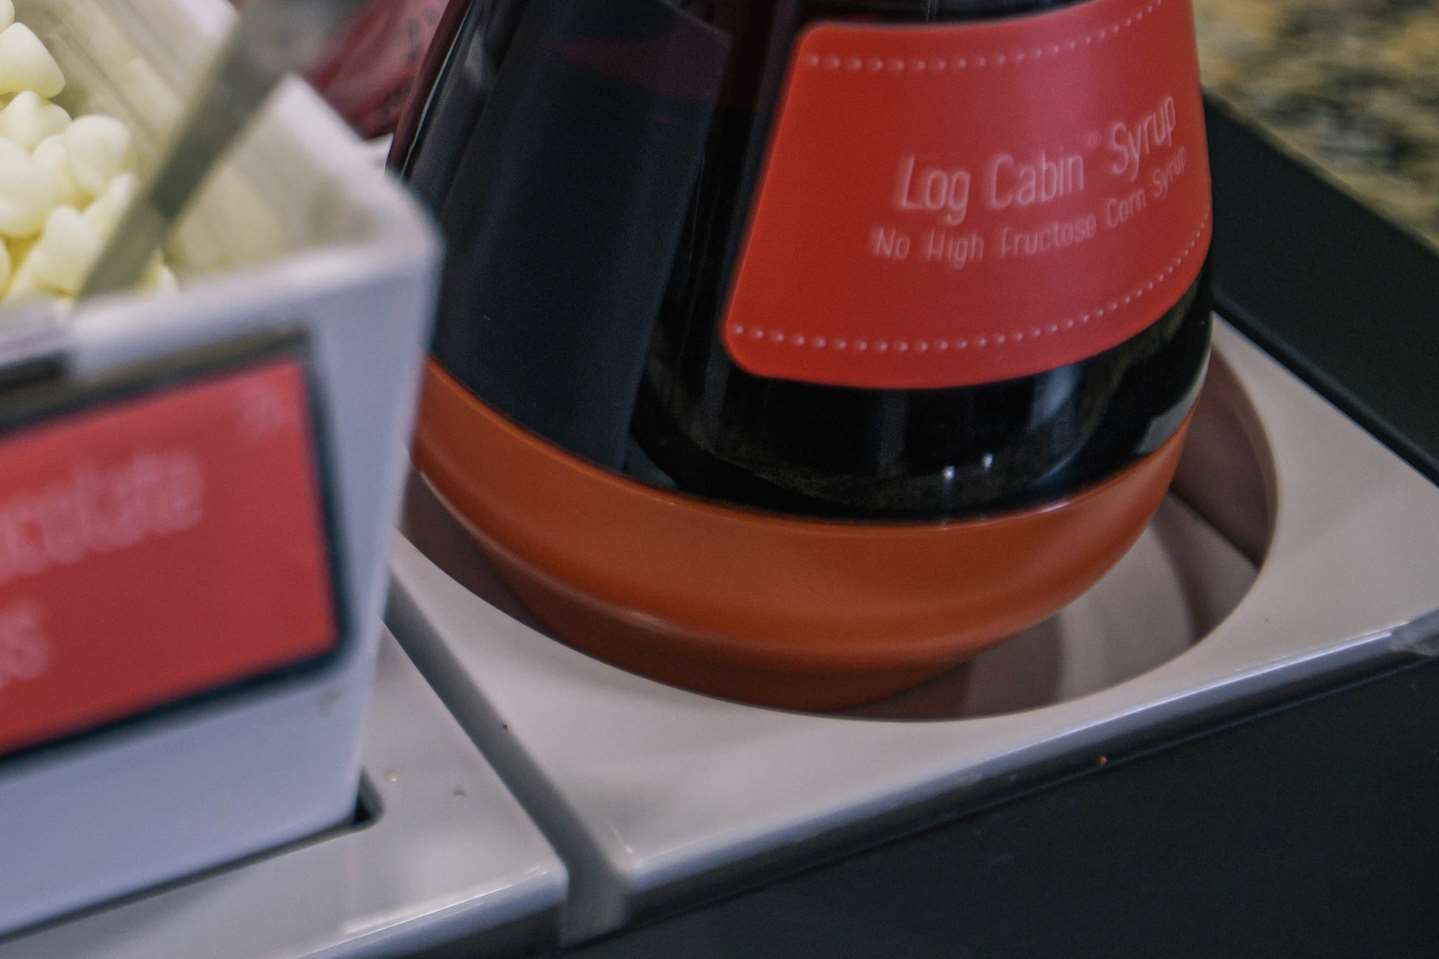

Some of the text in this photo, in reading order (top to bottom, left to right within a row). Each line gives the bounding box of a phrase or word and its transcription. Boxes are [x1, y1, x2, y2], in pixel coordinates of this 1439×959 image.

[896, 154, 971, 225] Log
[1110, 96, 1176, 183] Syrup
[871, 225, 911, 260] No
[926, 232, 984, 269] High
[1000, 214, 1097, 257] Fructose
[1104, 189, 1146, 229] Corn
